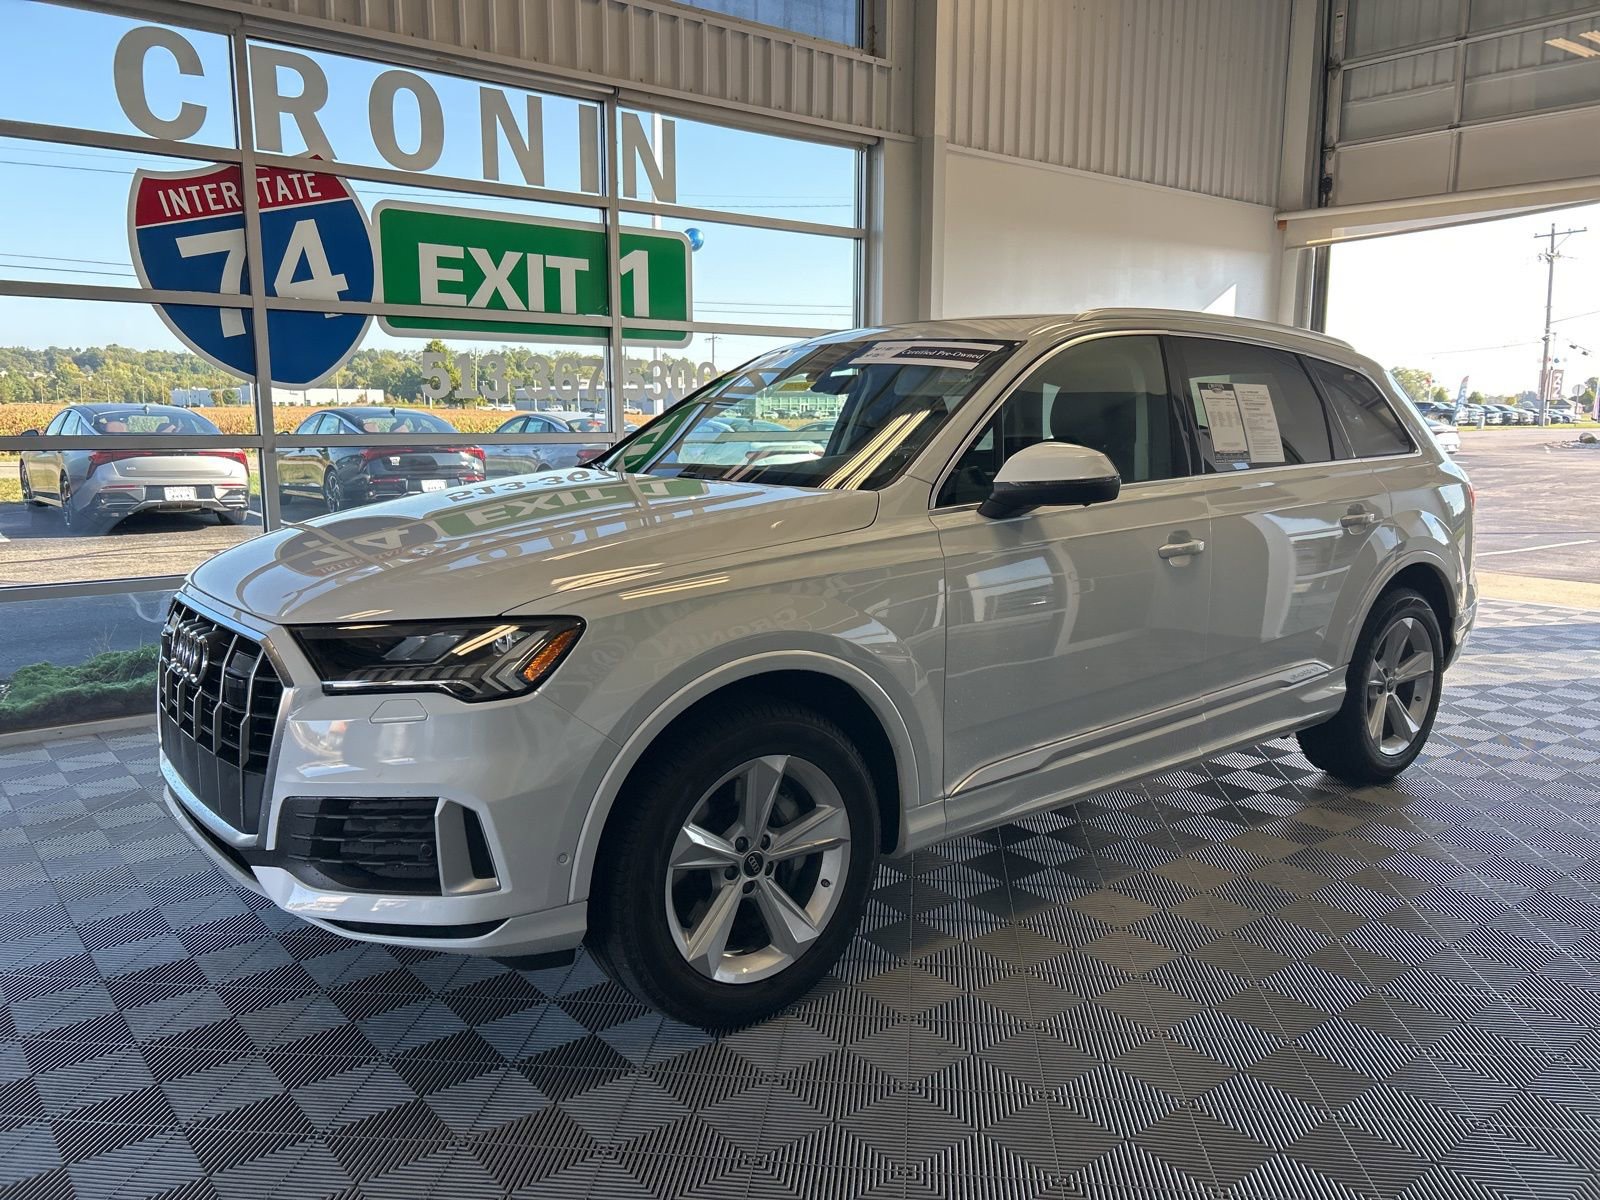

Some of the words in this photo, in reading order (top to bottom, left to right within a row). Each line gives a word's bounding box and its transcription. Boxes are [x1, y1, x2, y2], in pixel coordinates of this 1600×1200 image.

[113, 26, 677, 204] CRONIN
[158, 172, 322, 217] INTERTATE
[175, 218, 349, 338] 74
[418, 242, 589, 314] EXIT
[620, 249, 650, 318] 1
[901, 348, 936, 357] Certified
[937, 349, 985, 360] Pre-Owned
